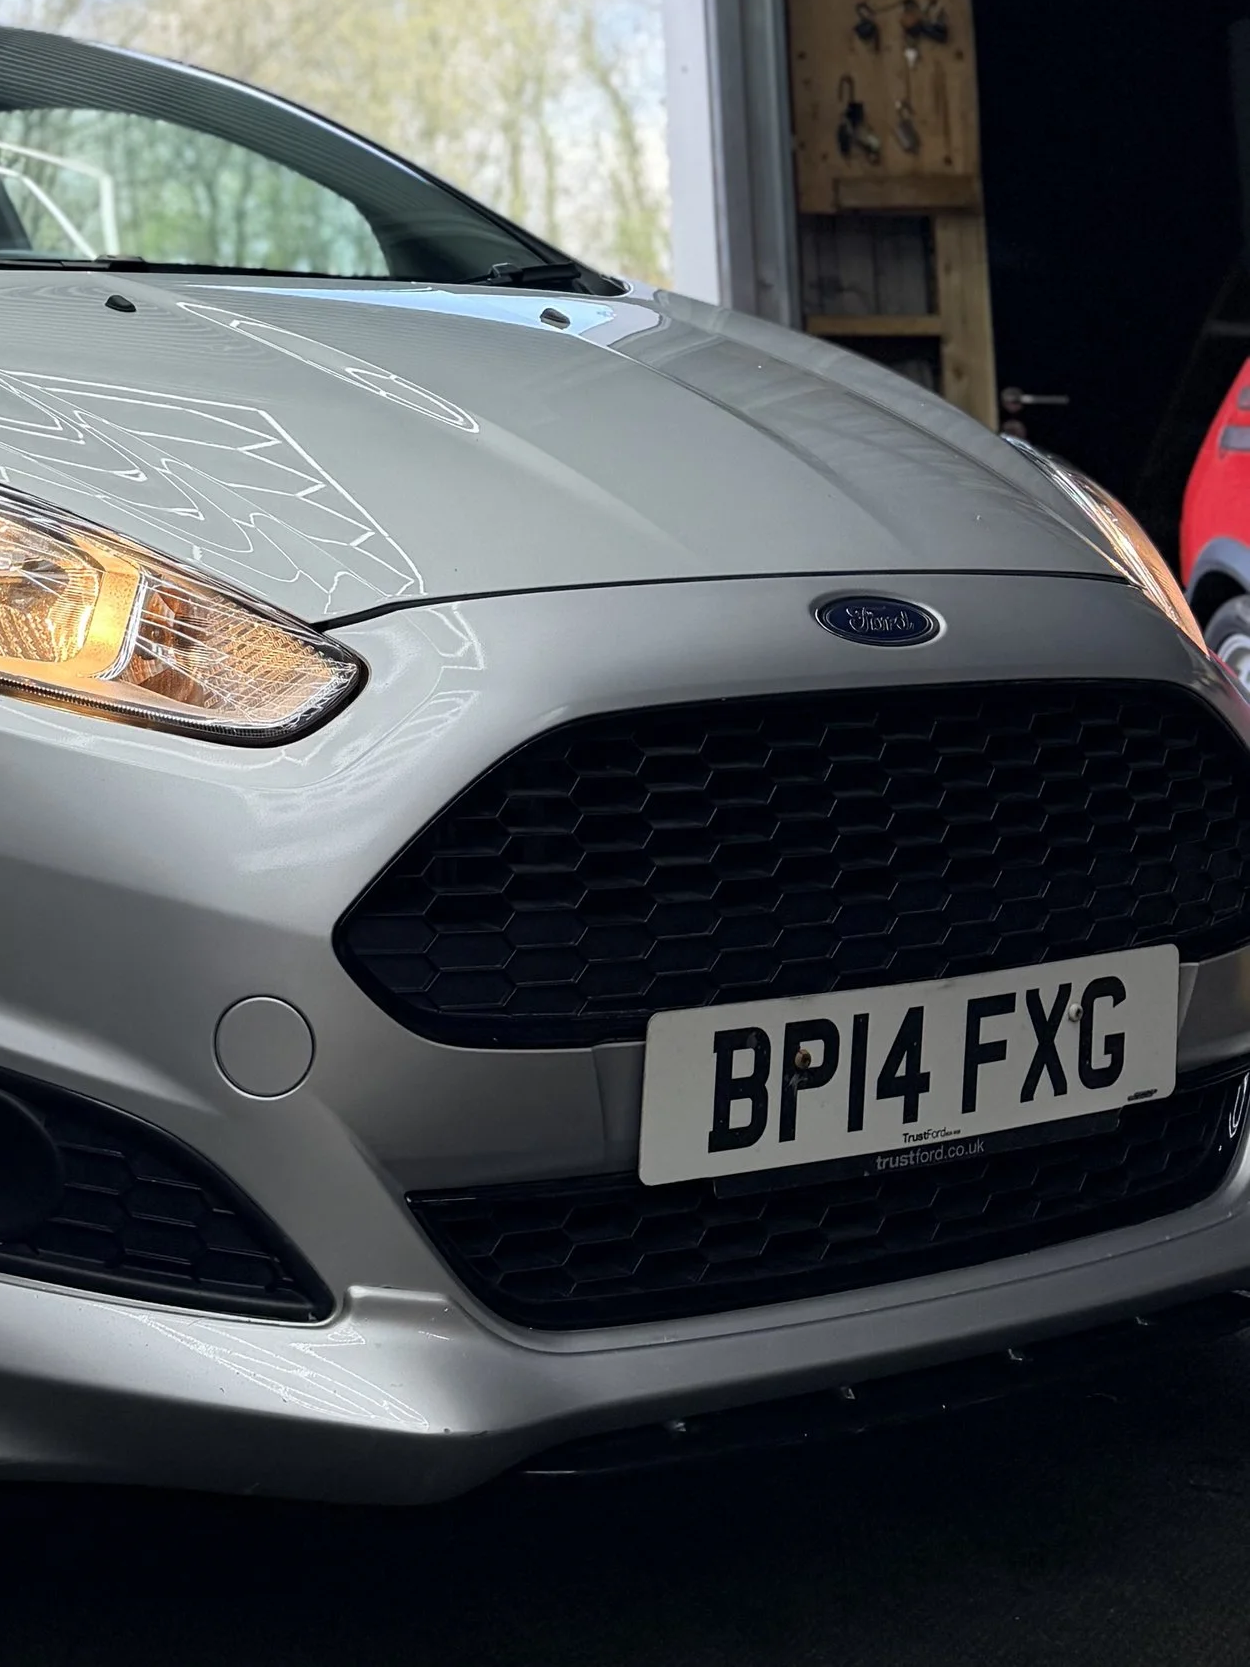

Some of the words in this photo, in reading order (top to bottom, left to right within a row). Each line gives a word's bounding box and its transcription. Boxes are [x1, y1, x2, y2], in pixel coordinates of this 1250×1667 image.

[845, 606, 916, 633] Ford
[707, 1005, 931, 1154] BP14
[961, 975, 1127, 1114] FXG
[902, 1127, 947, 1143] TrustFord
[876, 1137, 985, 1170] trustford.co.uk
